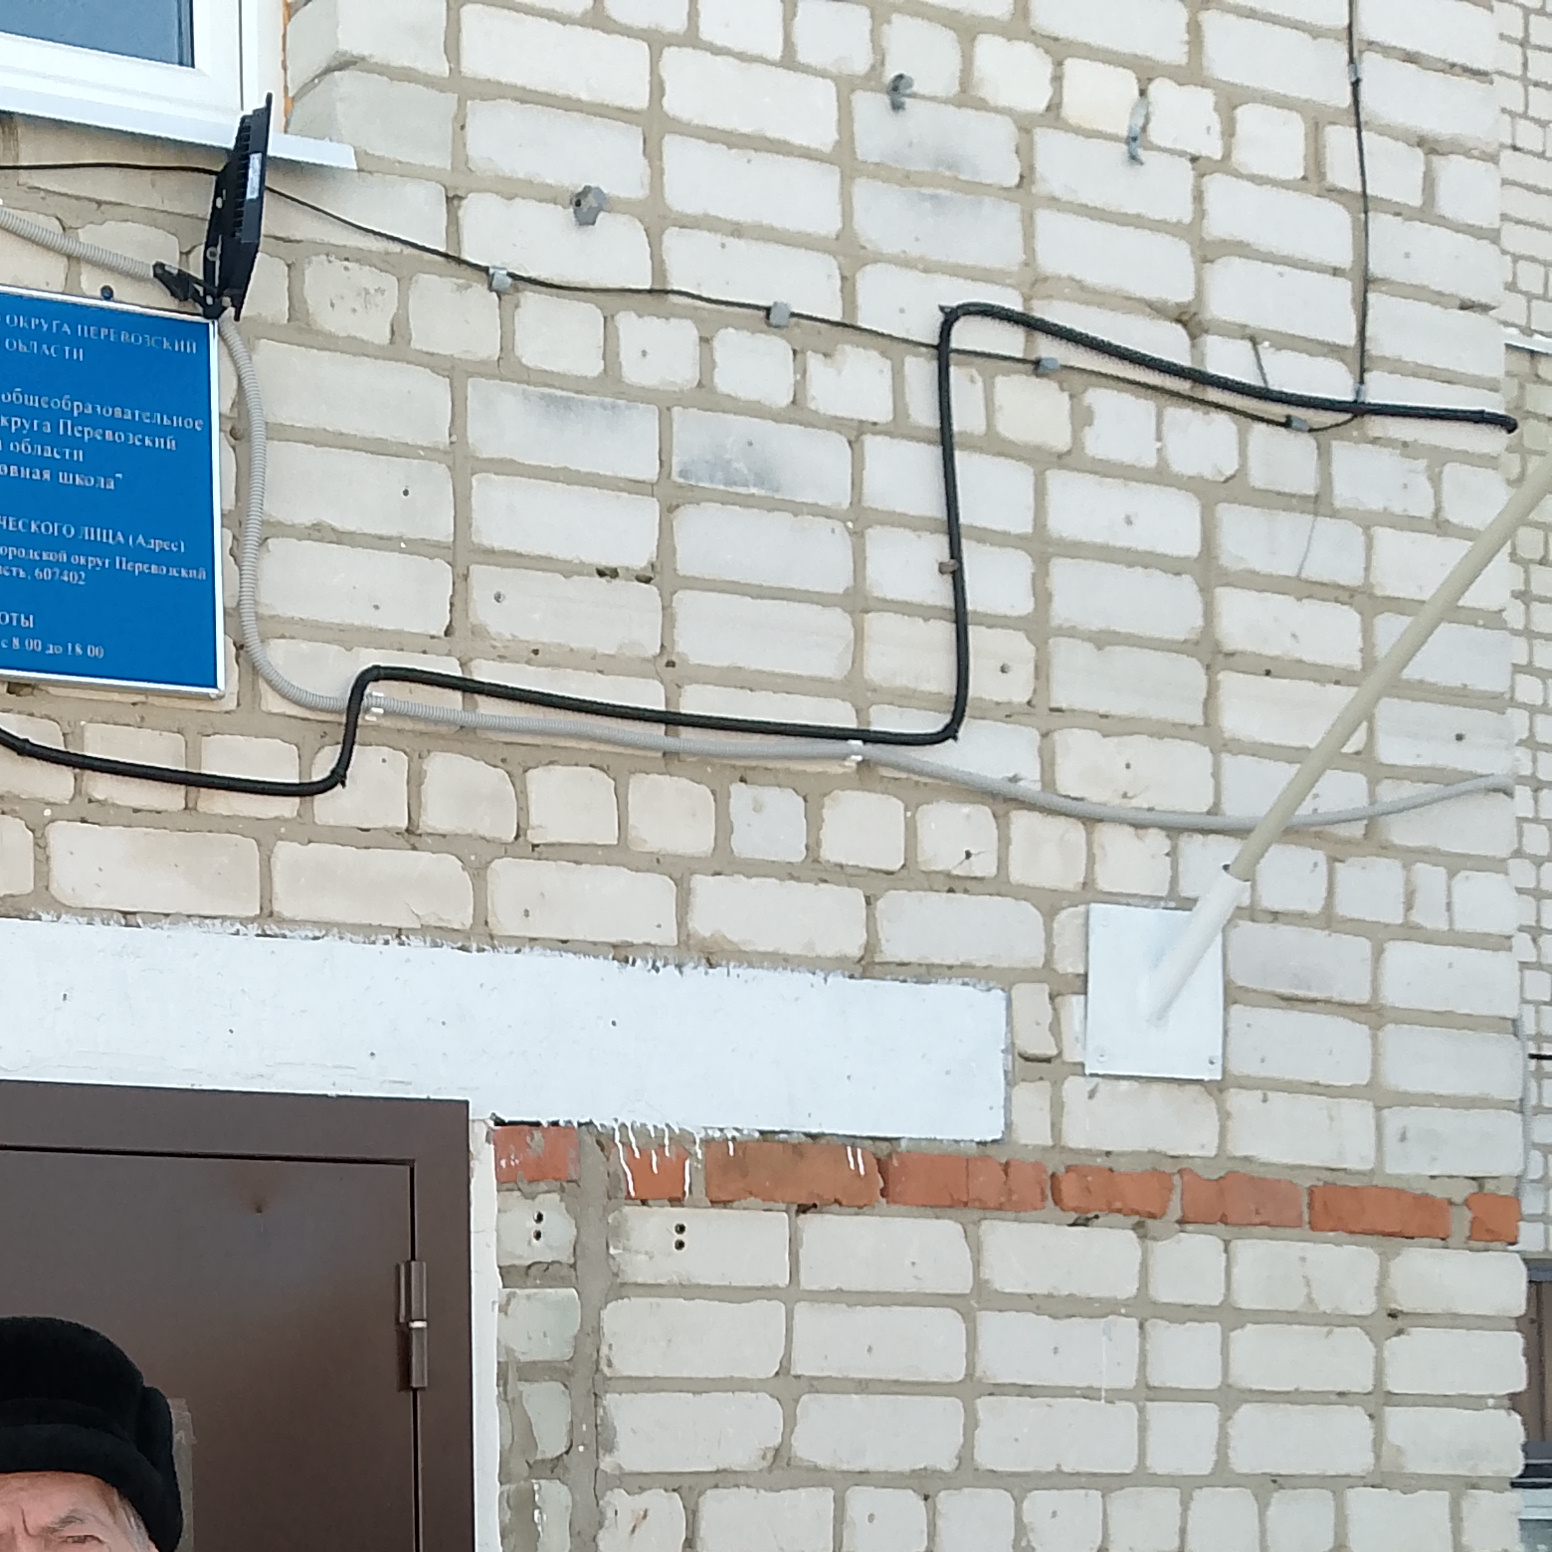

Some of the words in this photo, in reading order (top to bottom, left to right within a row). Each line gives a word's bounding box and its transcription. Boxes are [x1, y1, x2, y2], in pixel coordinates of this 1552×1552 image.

[5, 314, 71, 335] ОКРУГА
[77, 324, 197, 354] ПЕРЕВОЗСКИЙ
[5, 338, 84, 362] ОБЛАСТИ
[1, 387, 204, 431] общеобразовательное
[59, 418, 177, 451] Перевозский
[9, 438, 84, 462] области
[79, 526, 125, 545] ЛИЦА
[34, 567, 86, 585] 607402
[70, 554, 110, 570] округ
[115, 555, 207, 580] Перевозский
[45, 643, 63, 655] до
